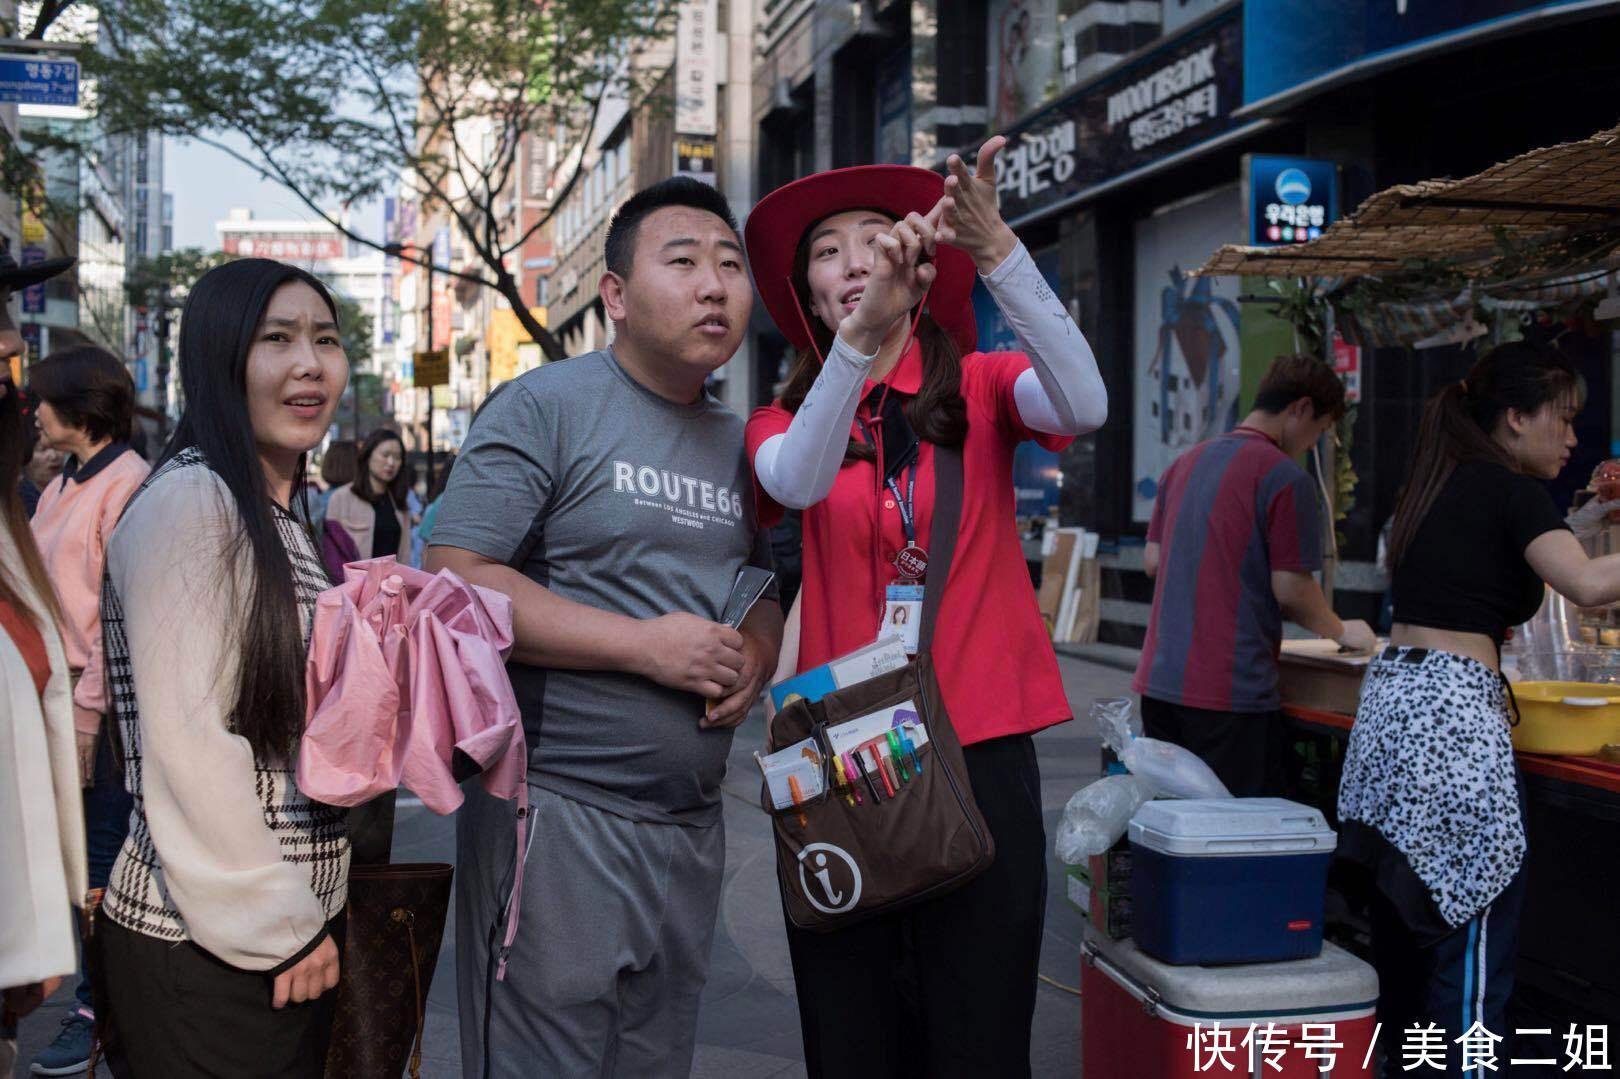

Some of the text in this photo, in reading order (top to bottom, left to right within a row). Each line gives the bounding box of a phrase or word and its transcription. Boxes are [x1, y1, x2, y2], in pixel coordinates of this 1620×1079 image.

[1265, 203, 1325, 227] 우리은행
[634, 498, 662, 508] Between
[663, 504, 674, 512] LOS
[675, 507, 699, 519] ANGELES
[711, 515, 735, 527] CHICAGO
[671, 515, 704, 529] WESTWOOD
